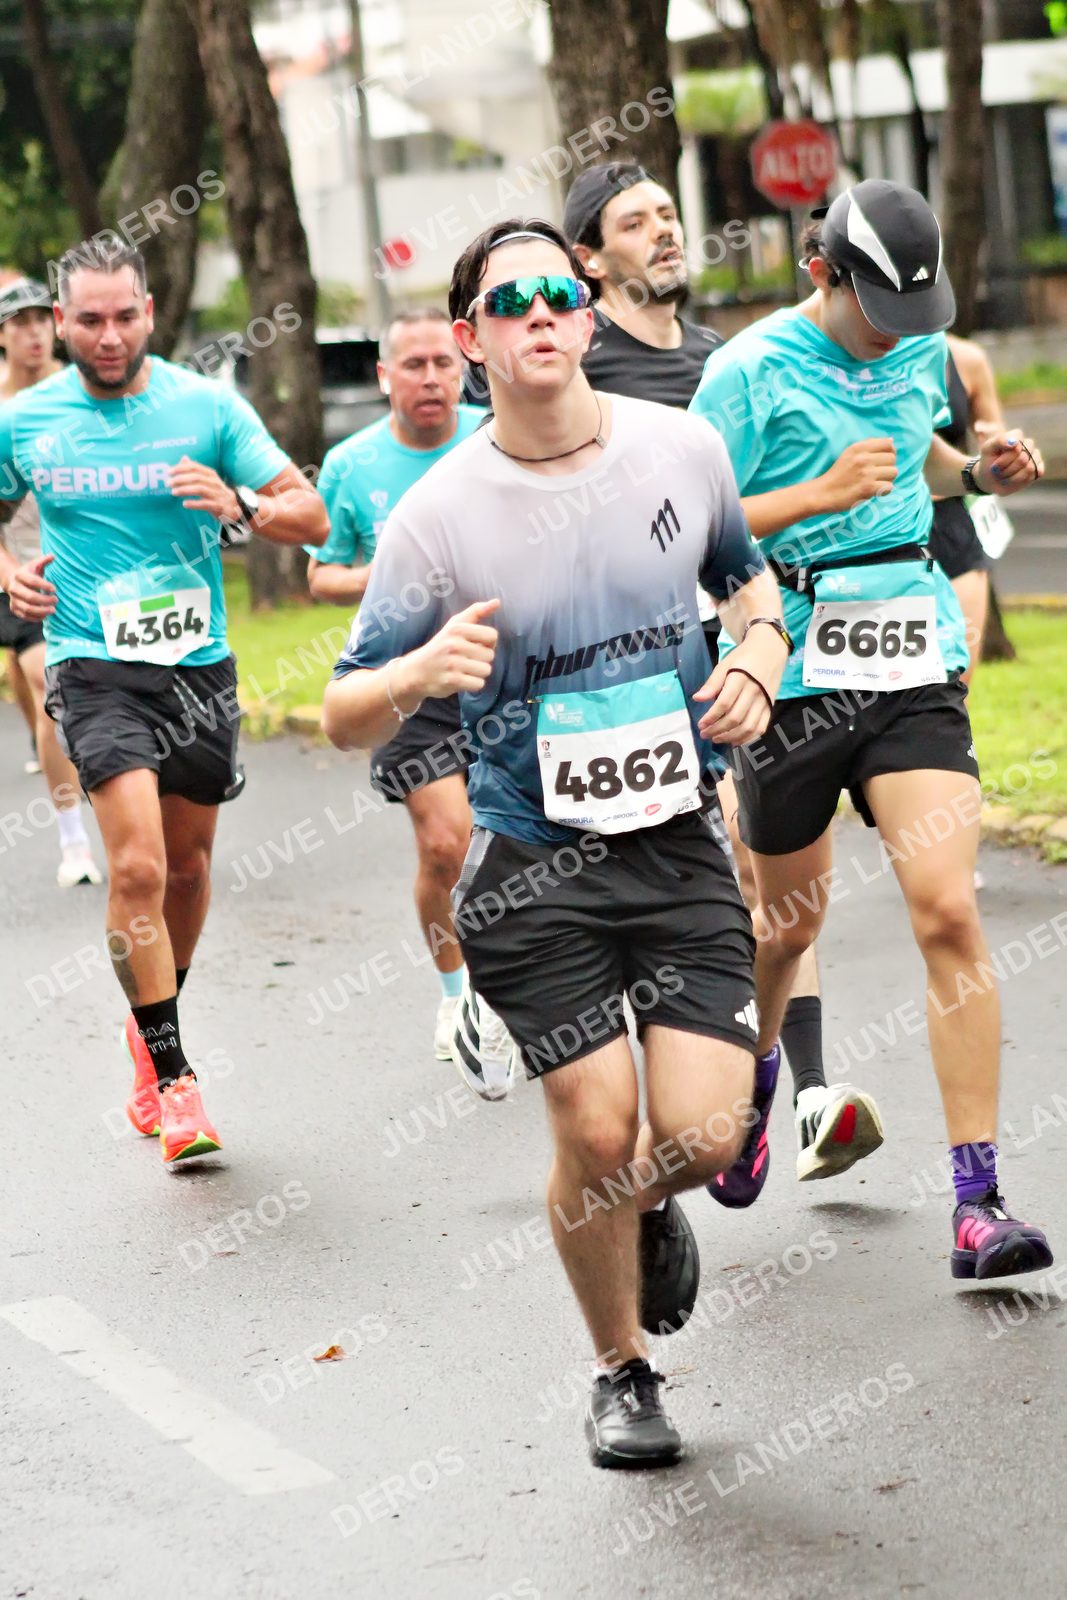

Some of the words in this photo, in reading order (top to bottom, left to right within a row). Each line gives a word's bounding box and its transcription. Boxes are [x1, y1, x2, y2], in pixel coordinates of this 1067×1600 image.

[760, 144, 828, 181] ALTO
[152, 436, 197, 449] BROOKS
[31, 463, 171, 493] PERDUR
[116, 607, 204, 650] 4364
[816, 619, 927, 659] 6665
[555, 740, 689, 802] 4862
